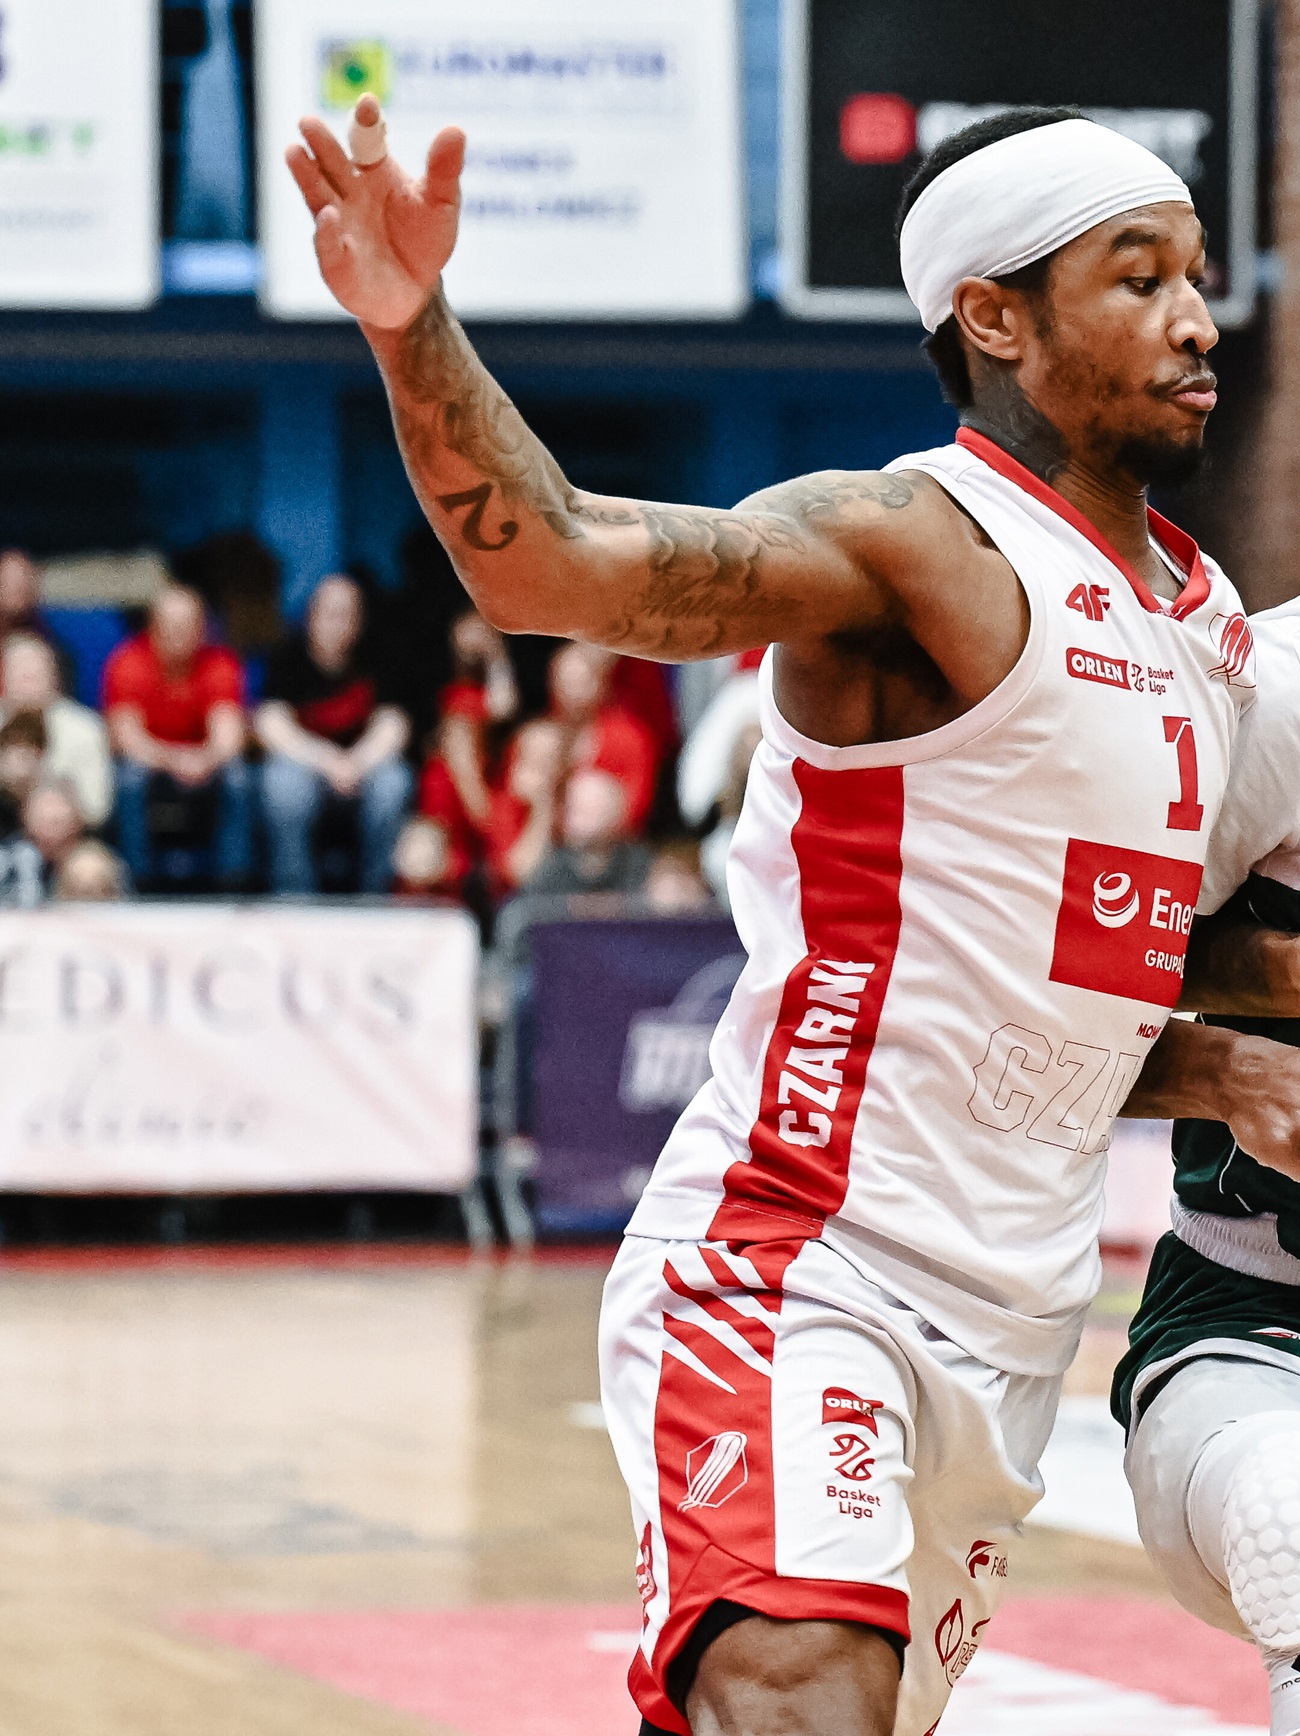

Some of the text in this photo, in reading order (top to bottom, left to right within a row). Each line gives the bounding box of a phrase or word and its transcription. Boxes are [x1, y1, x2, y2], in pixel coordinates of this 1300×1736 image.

[1065, 583, 1110, 622] 4F
[1071, 653, 1124, 683] ORLEN
[1147, 666, 1174, 680] Basket
[1149, 681, 1166, 695] Liga
[1162, 716, 1204, 831] 1
[826, 1485, 881, 1507] Basket
[838, 1501, 873, 1519] Liga
